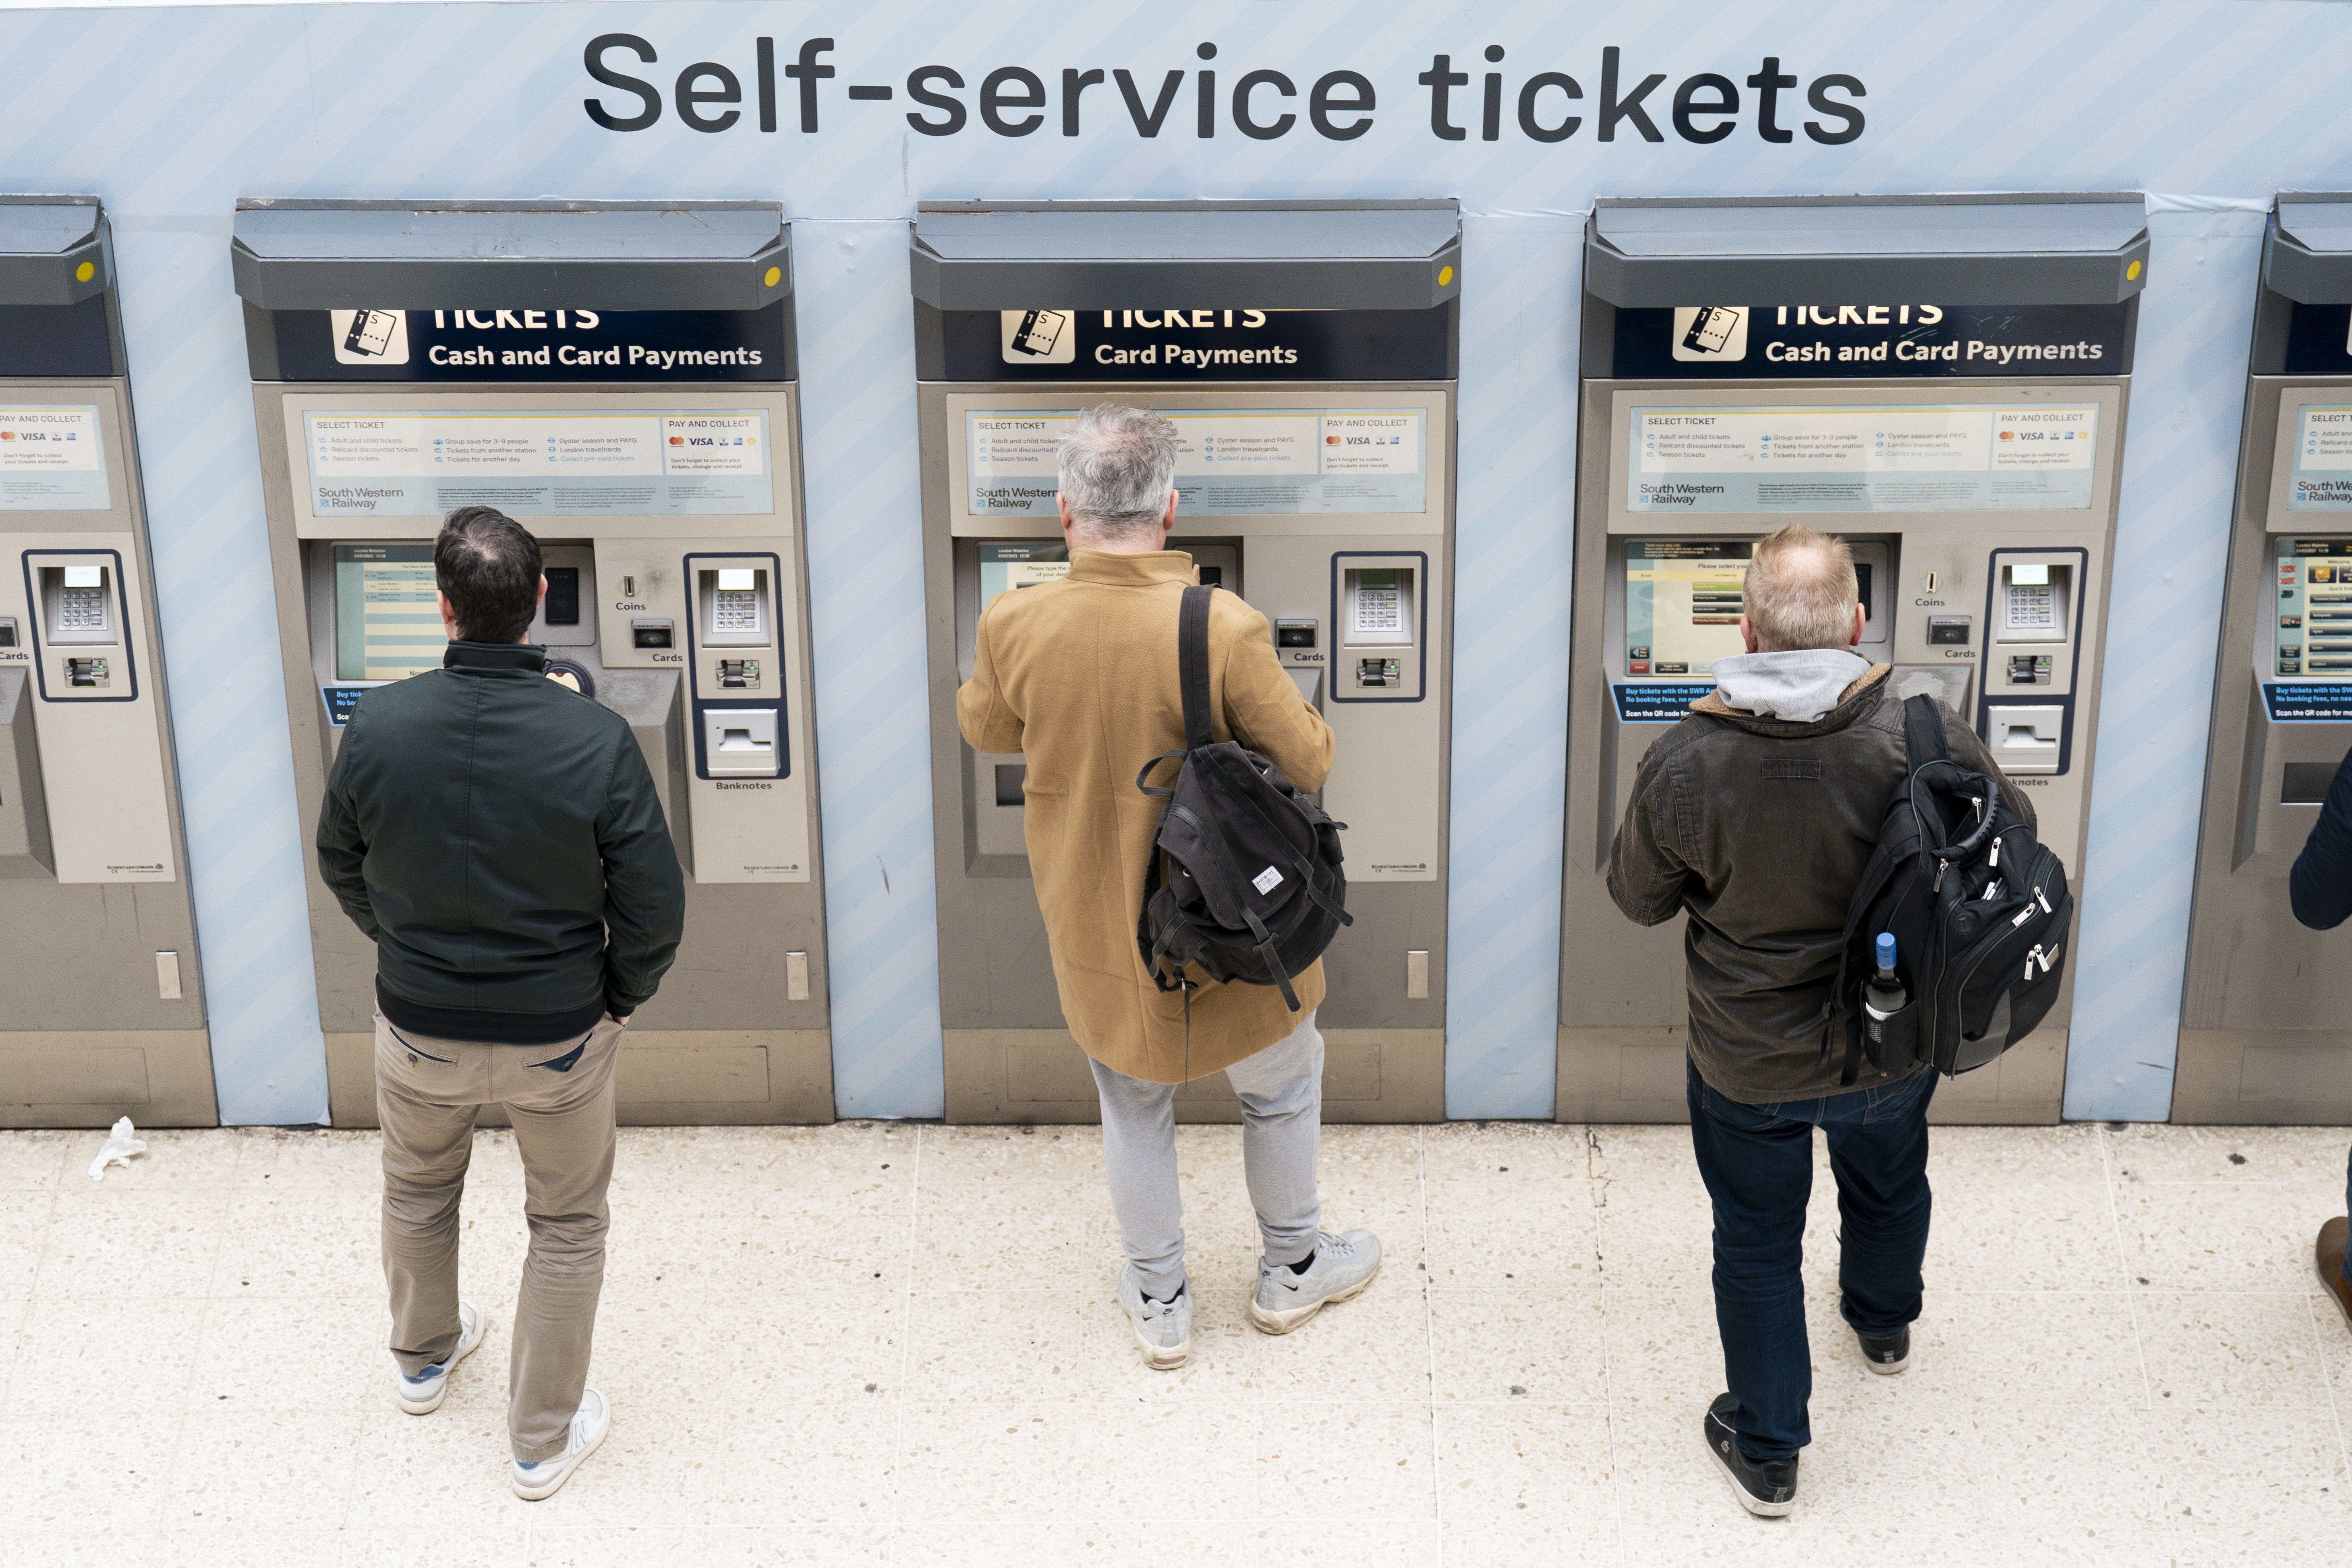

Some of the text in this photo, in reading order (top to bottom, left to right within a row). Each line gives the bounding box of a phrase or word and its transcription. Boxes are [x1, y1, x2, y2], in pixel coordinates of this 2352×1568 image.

[582, 32, 1867, 146] Self-service tickets
[428, 344, 763, 371] Cash and Card Payments
[1094, 344, 1298, 369] Card Payments
[1765, 340, 2103, 365] Cash and Card Payments
[20, 433, 46, 441] VISA
[688, 437, 714, 445] VISA
[2020, 432, 2044, 440] VISA
[1640, 484, 1724, 493] South Western
[2298, 481, 2333, 491] South
[319, 487, 404, 497] South Western
[976, 487, 1058, 498] South Western
[332, 498, 376, 510] Railway
[988, 498, 1032, 510] Railway
[1652, 494, 1696, 505] Railway
[615, 602, 646, 610] Coins
[1915, 598, 1945, 606] Coins
[652, 653, 683, 662] Cards
[1294, 653, 1324, 661] Cards
[1945, 650, 1975, 658] Cards
[2286, 695, 2313, 703] booking
[1256, 870, 1274, 884] SANDQVIST
